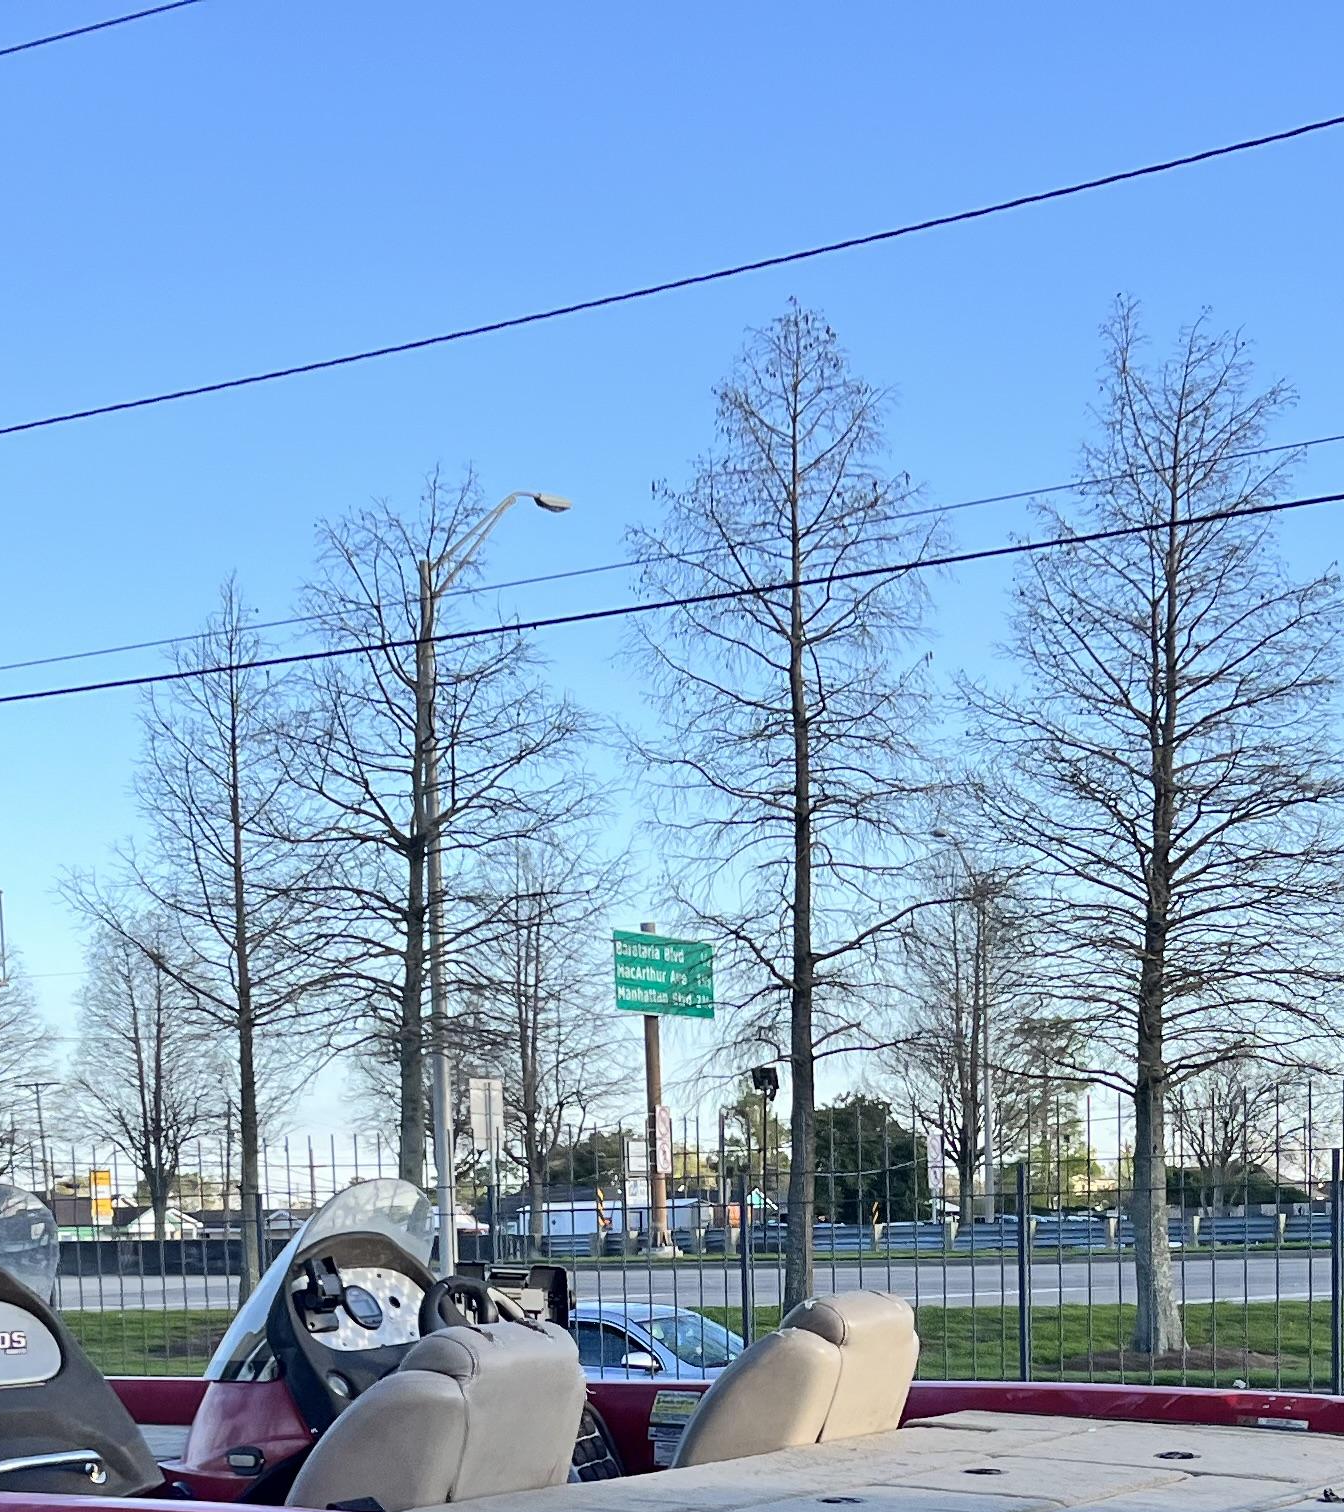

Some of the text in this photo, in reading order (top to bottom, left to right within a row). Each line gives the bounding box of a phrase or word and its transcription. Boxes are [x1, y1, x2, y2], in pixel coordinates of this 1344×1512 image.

[664, 946, 684, 963] Blvd
[616, 963, 666, 983] MacArthur
[617, 985, 668, 1003] Manhattan
